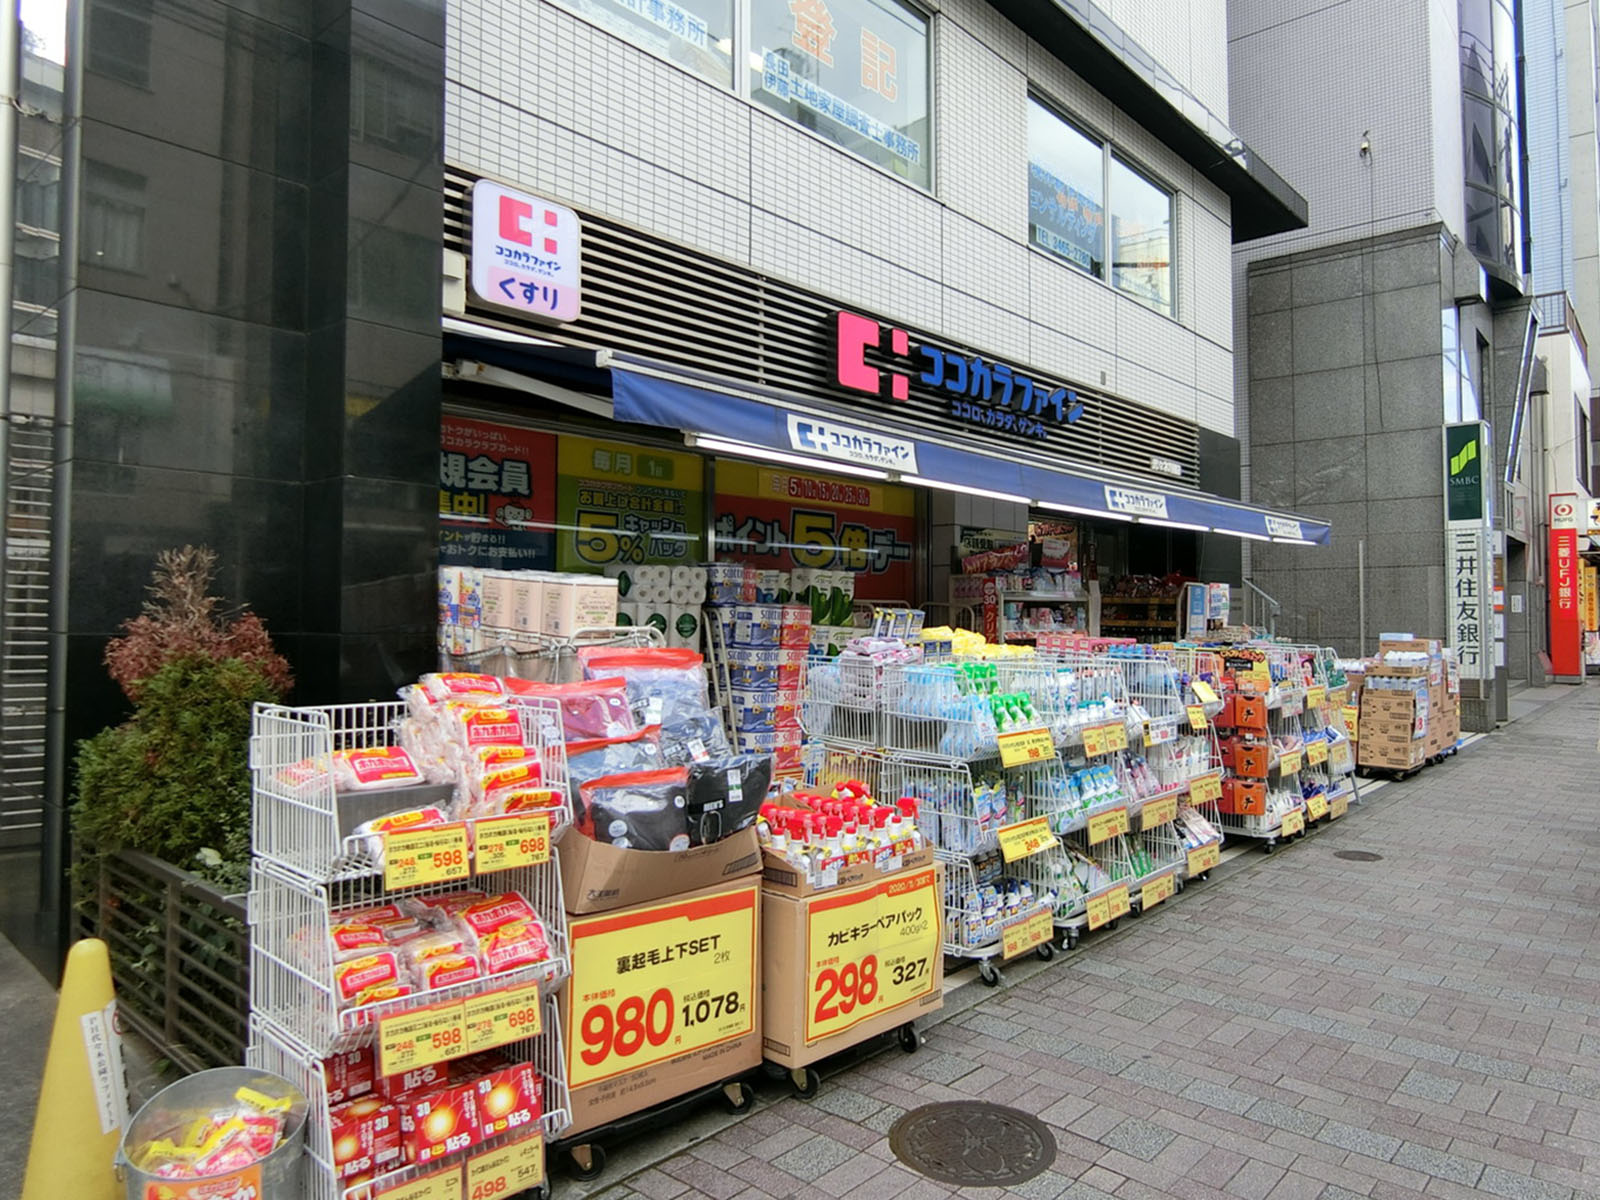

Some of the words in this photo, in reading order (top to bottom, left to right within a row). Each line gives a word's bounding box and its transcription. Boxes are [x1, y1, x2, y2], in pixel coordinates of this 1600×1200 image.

[495, 244, 562, 272] ココカラファイン
[499, 277, 559, 311] くすり
[919, 344, 1085, 424] ココカラファイン
[829, 431, 909, 460] ココカラファイン
[1450, 475, 1480, 486] SMBC
[1558, 535, 1572, 609] 三菱UFJ銀行
[1456, 533, 1480, 666] 三井住友銀行
[519, 836, 546, 855] 698
[433, 849, 463, 868] 598
[616, 934, 721, 975] 裏起毛上下SET
[713, 949, 731, 965] 2枚
[892, 957, 927, 986] 327
[814, 953, 878, 1024] 298
[508, 1007, 536, 1028] 698
[682, 991, 740, 1029] 1,078
[431, 1027, 462, 1049] 598
[580, 987, 675, 1066] 980
[444, 1045, 462, 1056] 657
[403, 1065, 438, 1091] 貼る
[478, 1079, 493, 1095] 30
[415, 1101, 431, 1117] 30
[507, 1108, 532, 1127] 貼る
[374, 1114, 390, 1131] 30
[445, 1131, 472, 1151] 貼る
[342, 1156, 372, 1177] 貼る
[471, 1175, 507, 1200] 498
